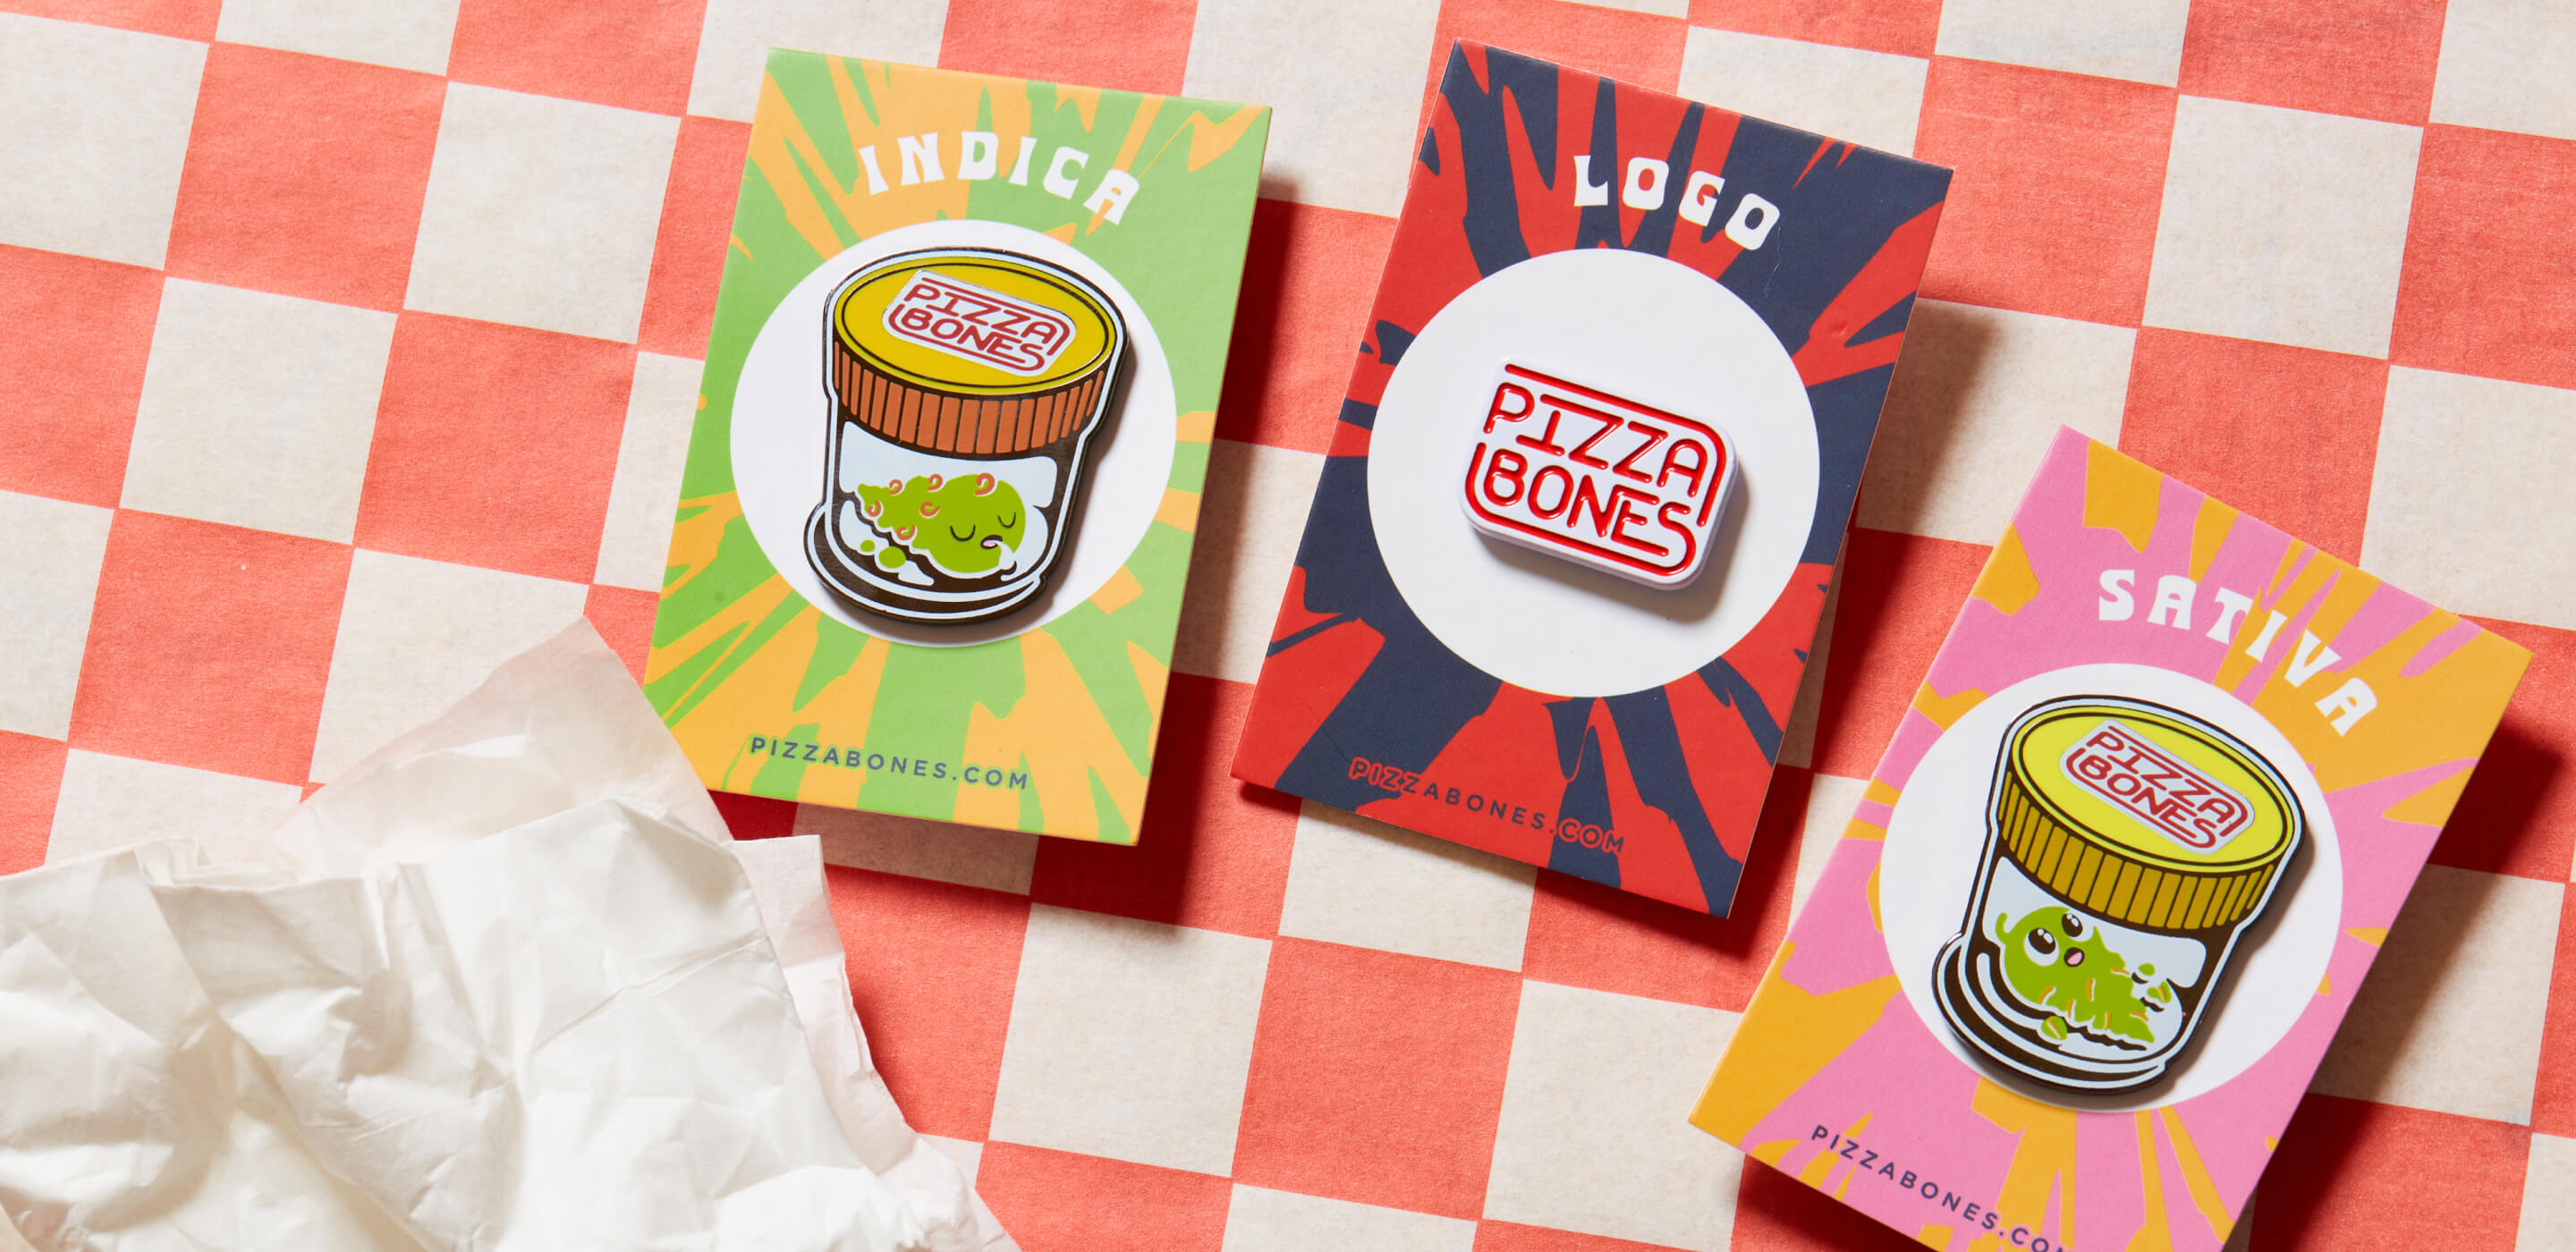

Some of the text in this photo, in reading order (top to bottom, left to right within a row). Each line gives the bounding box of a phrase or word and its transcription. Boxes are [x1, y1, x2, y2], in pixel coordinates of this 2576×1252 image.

[858, 131, 1140, 224] INDICA
[1573, 155, 1780, 250] LOGO
[901, 308, 1046, 371] BONES
[903, 283, 1057, 344] PIZZA
[1483, 382, 1708, 497] PIZZA
[1482, 447, 1697, 576] BONES
[2098, 569, 2377, 736] SATIVA
[750, 737, 1029, 791] PIZZABONES.COM
[1350, 758, 1624, 853] PIZZABONES.COM
[2078, 755, 2216, 849] BONES
[2086, 731, 2235, 824] PIZZA
[1811, 1124, 2063, 1252] PIZZABONES.CO
